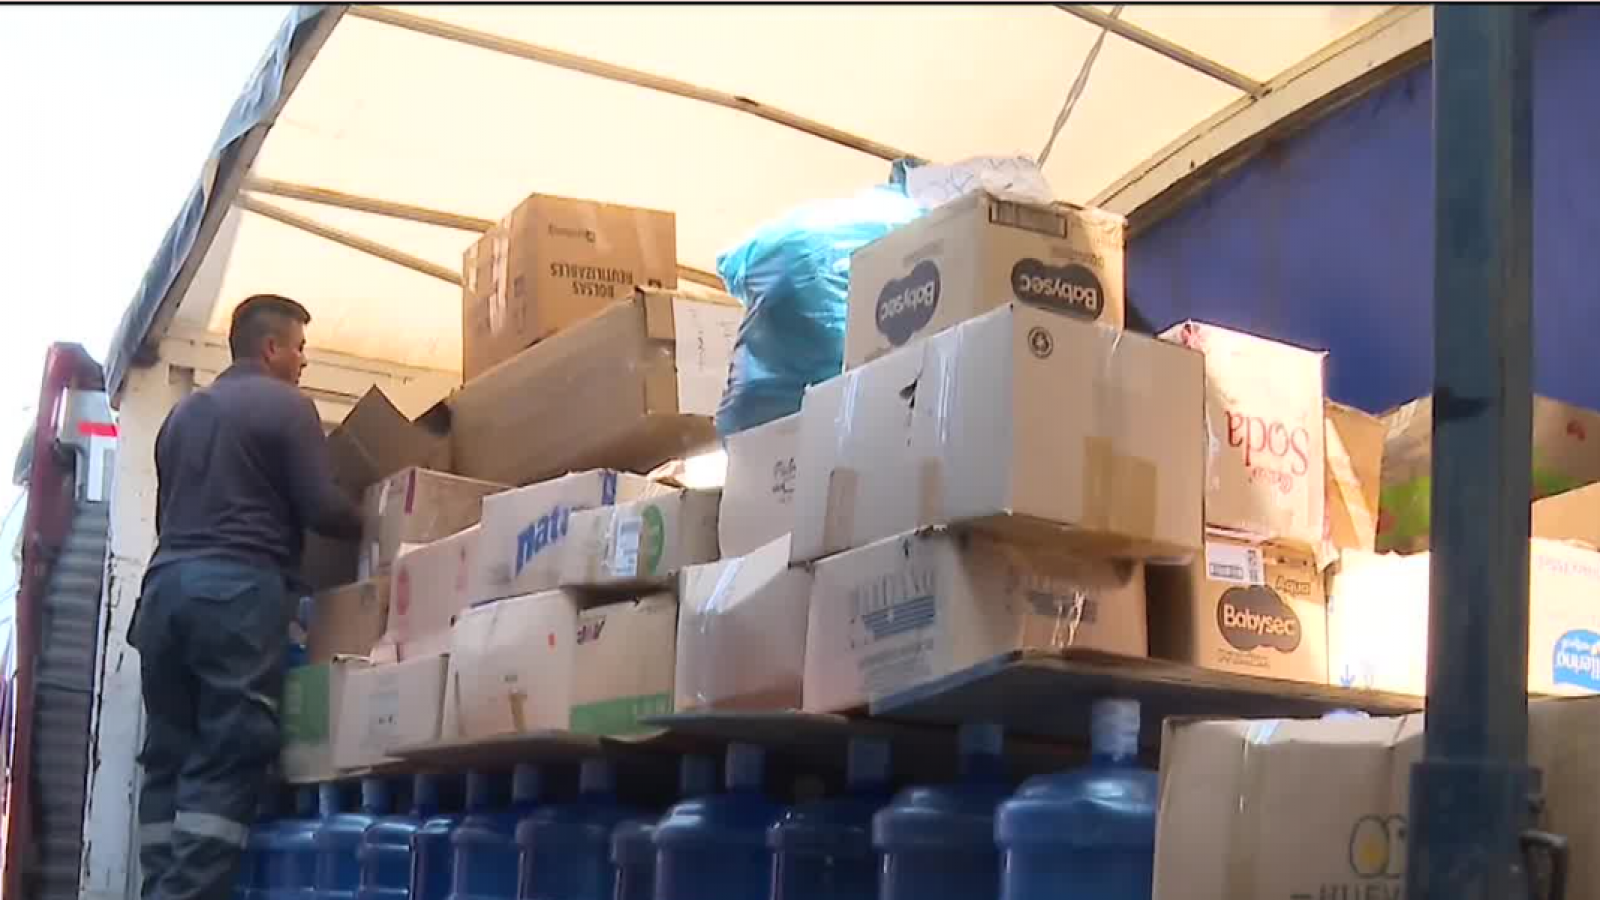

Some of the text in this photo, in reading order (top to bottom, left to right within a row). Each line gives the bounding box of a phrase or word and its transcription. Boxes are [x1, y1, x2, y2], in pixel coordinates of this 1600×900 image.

[549, 262, 634, 286] REUTILIZABLES
[571, 281, 615, 299] BOLSAS
[880, 280, 936, 321] Babysec
[1019, 273, 1098, 310] Babysec
[1224, 410, 1309, 477] Soda
[1223, 603, 1297, 635] Babysec
[1319, 882, 1401, 900] HUEV
